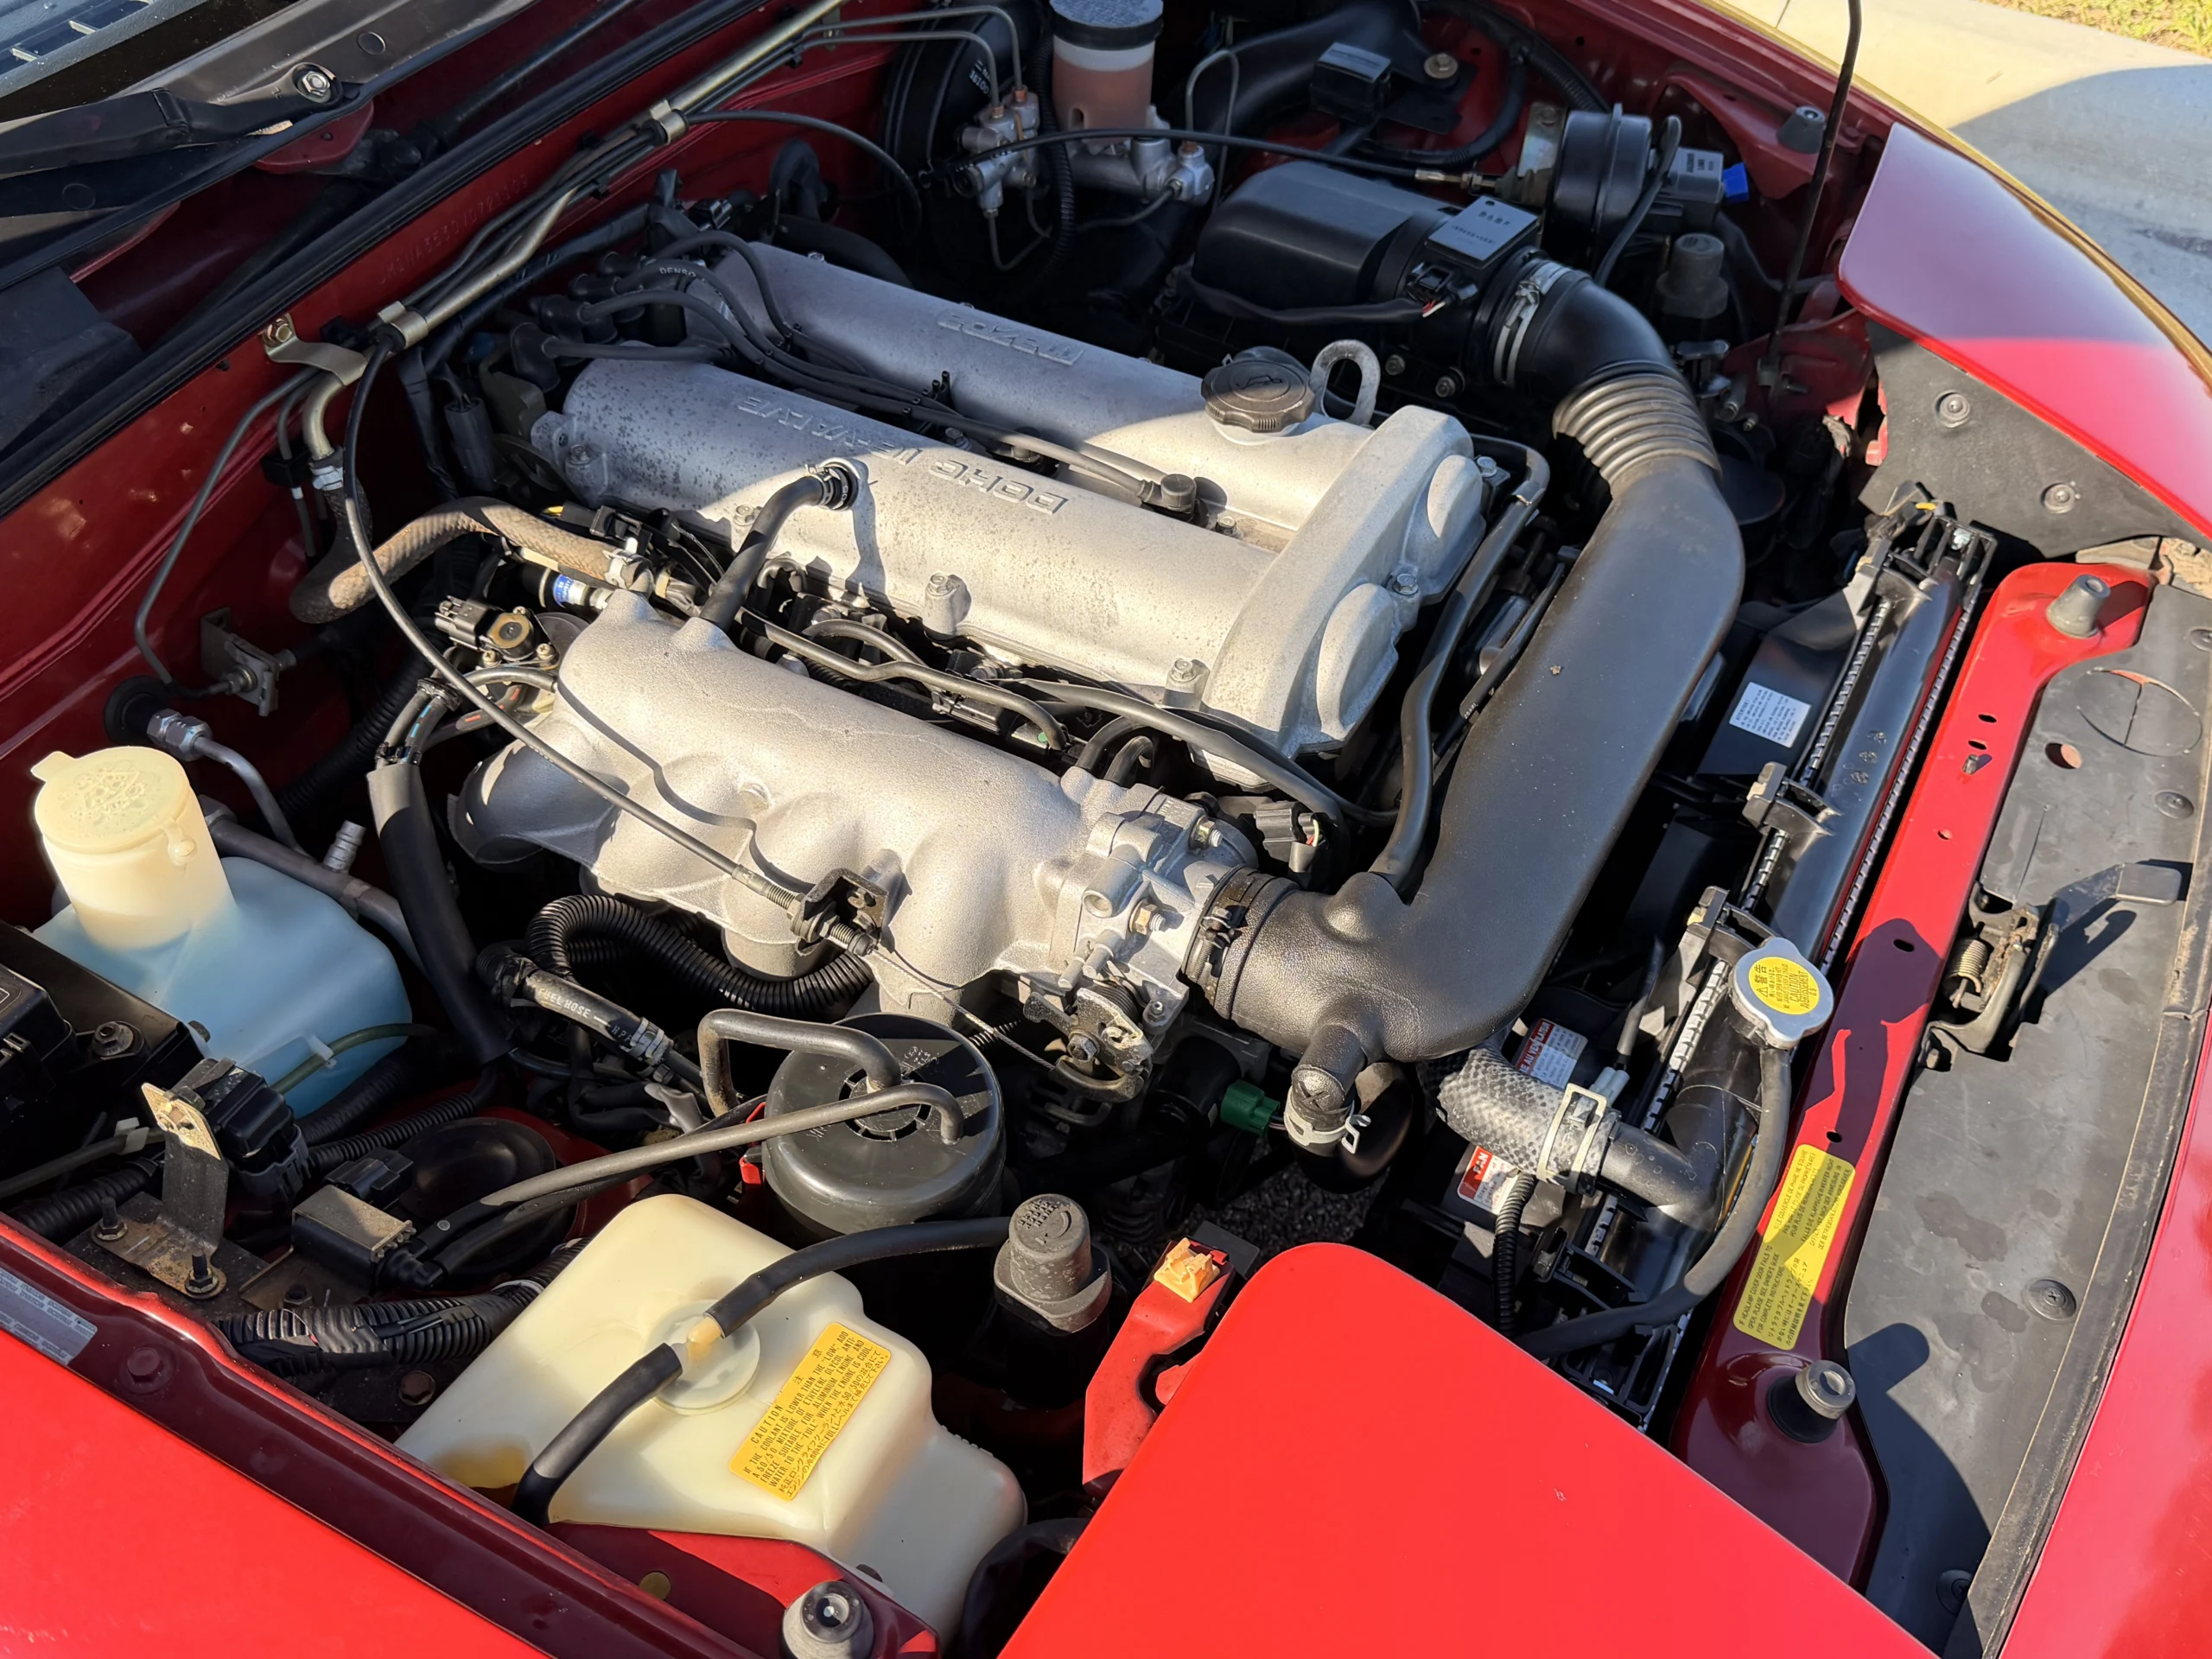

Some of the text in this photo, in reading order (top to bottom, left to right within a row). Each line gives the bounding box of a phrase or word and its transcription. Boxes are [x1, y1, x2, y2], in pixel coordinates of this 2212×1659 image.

[659, 265, 696, 276] DENSO
[925, 454, 1068, 515] DOHC
[1753, 963, 1767, 984] 警告
[1789, 973, 1799, 1001] CAUTION
[537, 987, 564, 1007] FUEL
[563, 998, 591, 1019] HOSE
[1528, 1020, 1550, 1055] VENTILATEUR
[1523, 1052, 1535, 1065] AU
[1471, 1151, 1489, 1174] FAN
[1793, 1211, 1802, 1224] PLUS
[1819, 1205, 1827, 1217] NACH
[1789, 1224, 1798, 1237] POUR
[1800, 1226, 1810, 1242] FALLS
[1740, 1294, 1754, 1319] HEADLAMP
[1749, 1279, 1760, 1294] COVER
[1755, 1266, 1764, 1279] DOOR
[1760, 1252, 1770, 1267] FAILS
[1751, 1296, 1764, 1315] PLEASE
[1758, 1286, 1767, 1296] SEE
[1770, 1252, 1780, 1266] GUIDE
[1759, 1298, 1773, 1323] COMPLETE
[749, 1452, 762, 1465] THE
[759, 1422, 784, 1451] COOLANT
[785, 1391, 805, 1414] LOWER
[800, 1375, 817, 1393] THAN
[812, 1362, 825, 1376] THE
[836, 1330, 849, 1344] ADD
[755, 1446, 779, 1472] 50/50
[775, 1417, 799, 1445] MIXTURE
[802, 1376, 828, 1406] ETHYLENE
[823, 1351, 844, 1376] GLYCOL
[841, 1335, 856, 1352] ANTI-
[760, 1338, 865, 1483] FREEZE SUITABLE FOR ALUMINIUM ENGINE AND
[750, 1403, 784, 1445] CAUTION
[767, 1464, 788, 1487] WATER
[784, 1454, 795, 1465] TO
[791, 1440, 804, 1454] THE
[815, 1400, 834, 1420] WHEN
[829, 1387, 842, 1401] THE
[836, 1368, 855, 1389] ENGINE
